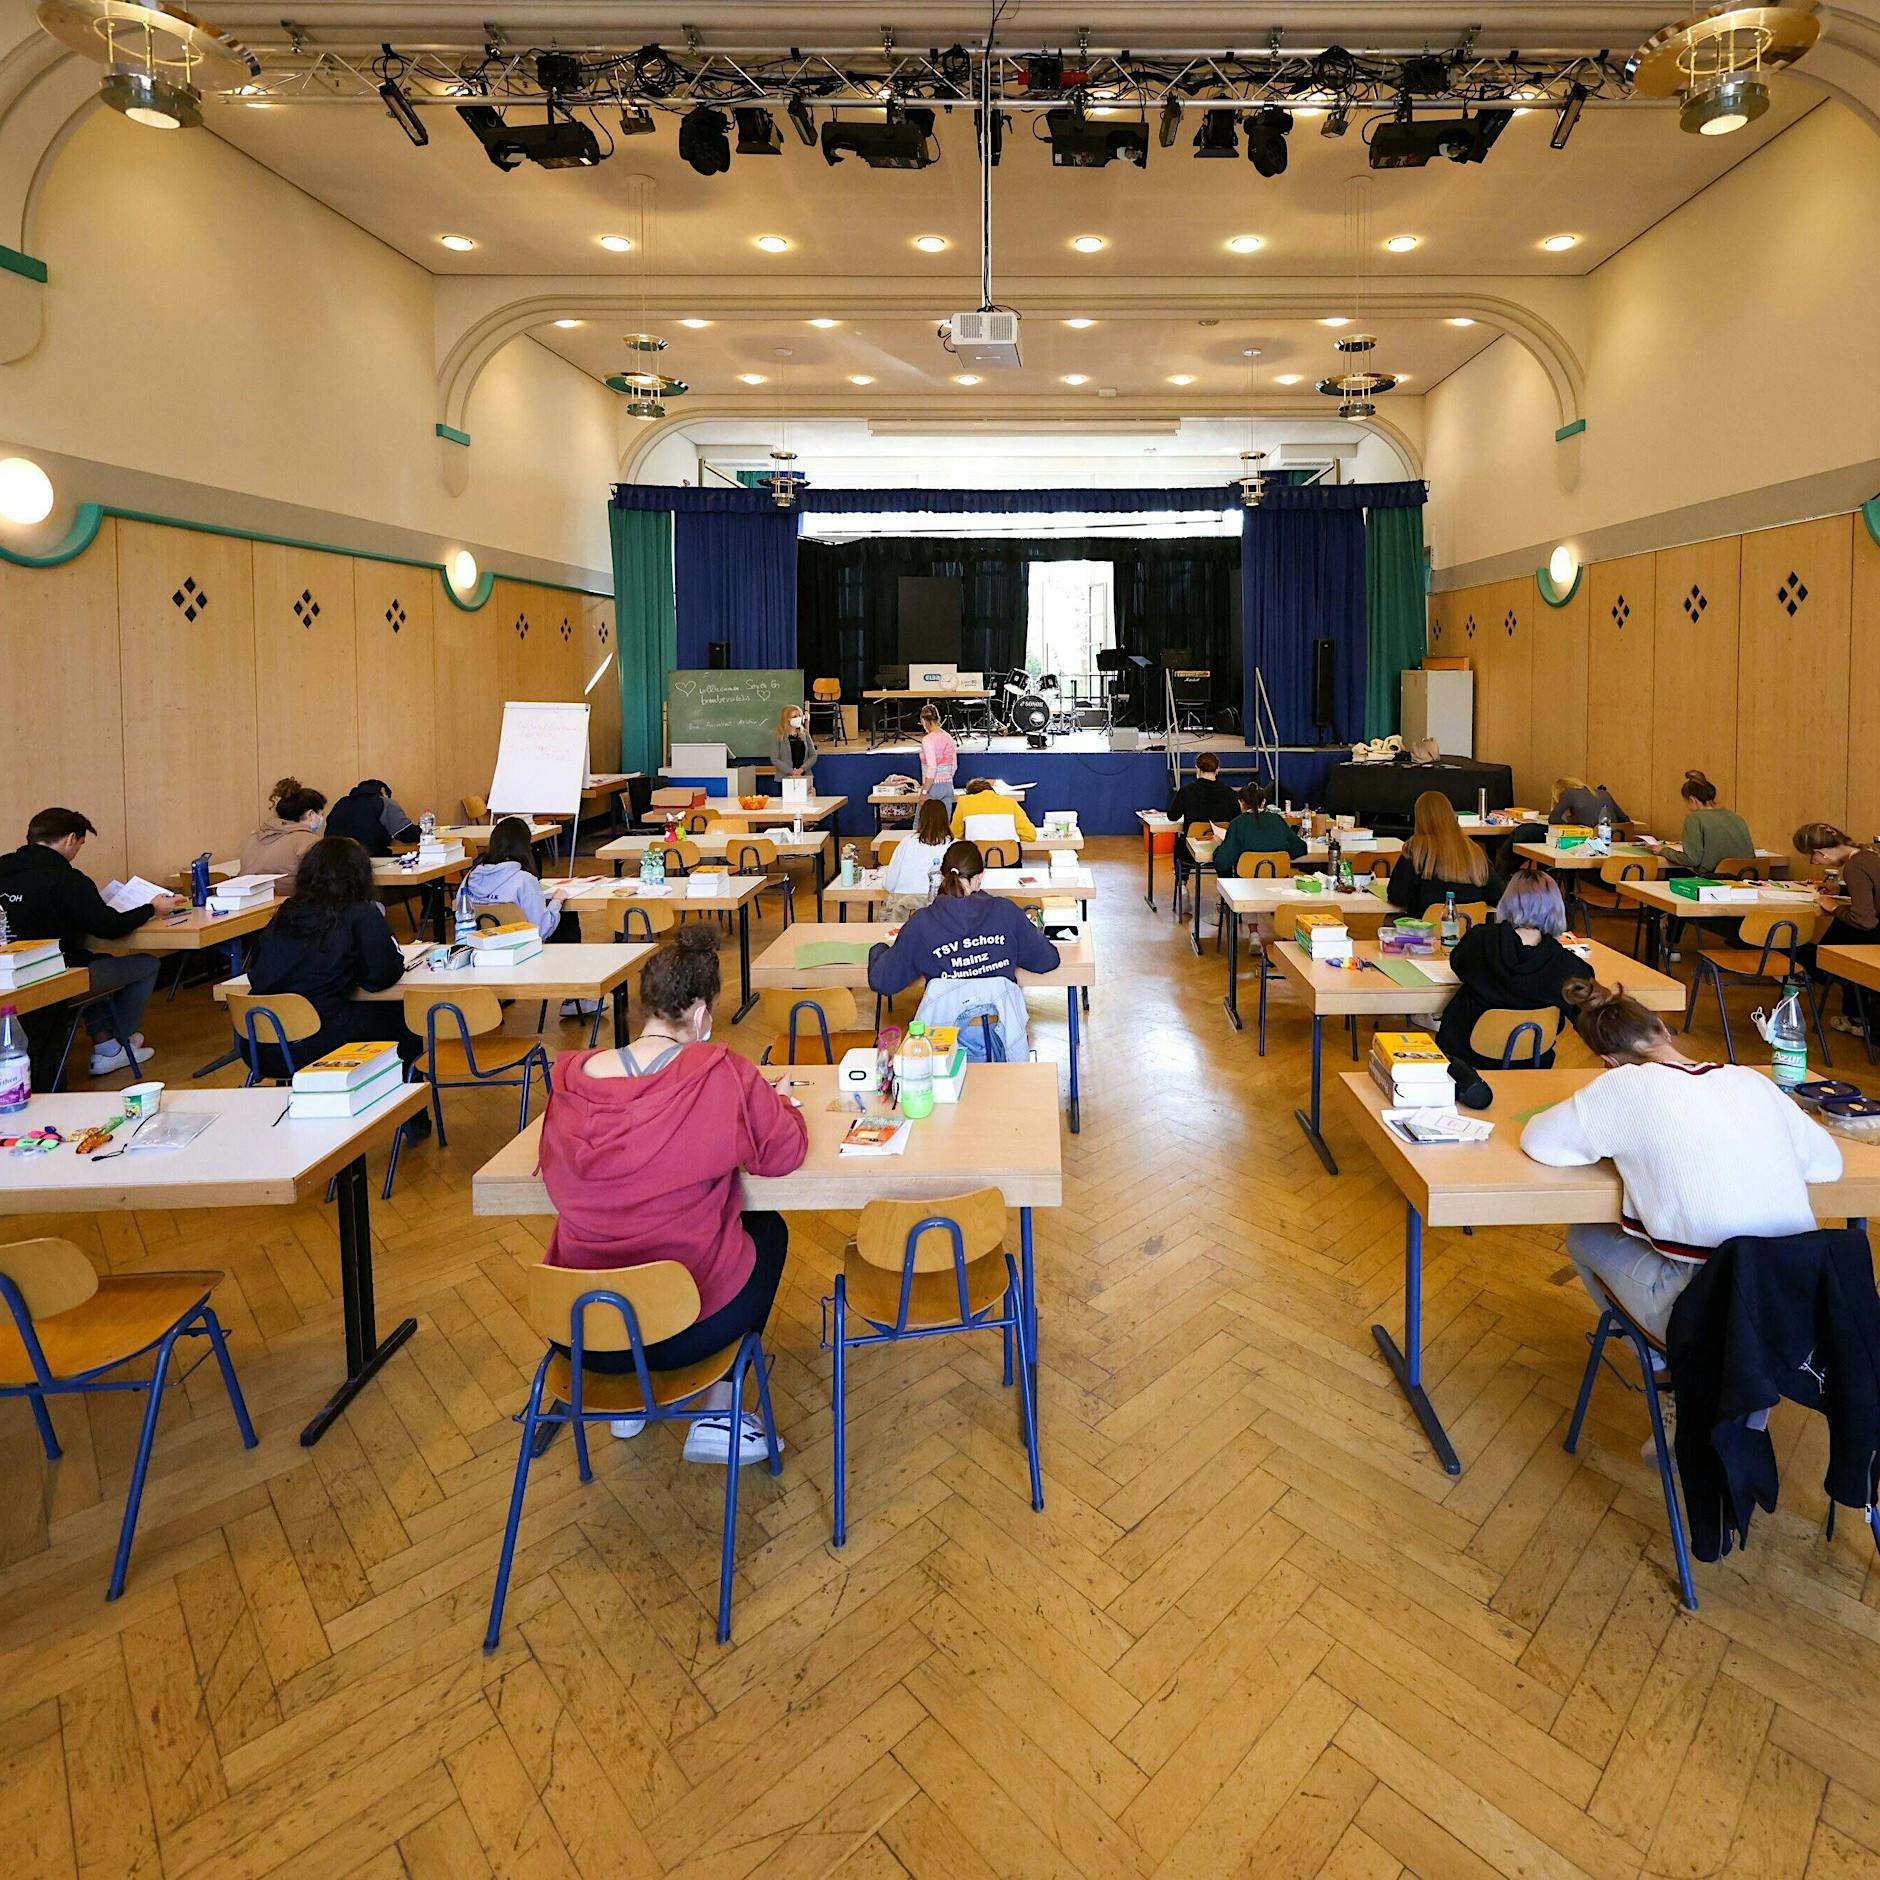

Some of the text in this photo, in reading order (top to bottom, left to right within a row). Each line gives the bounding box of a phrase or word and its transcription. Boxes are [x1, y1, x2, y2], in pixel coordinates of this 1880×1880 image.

[9, 894, 23, 902] OH
[932, 934, 1006, 958] TSV Schott
[950, 953, 990, 968] Mainz
